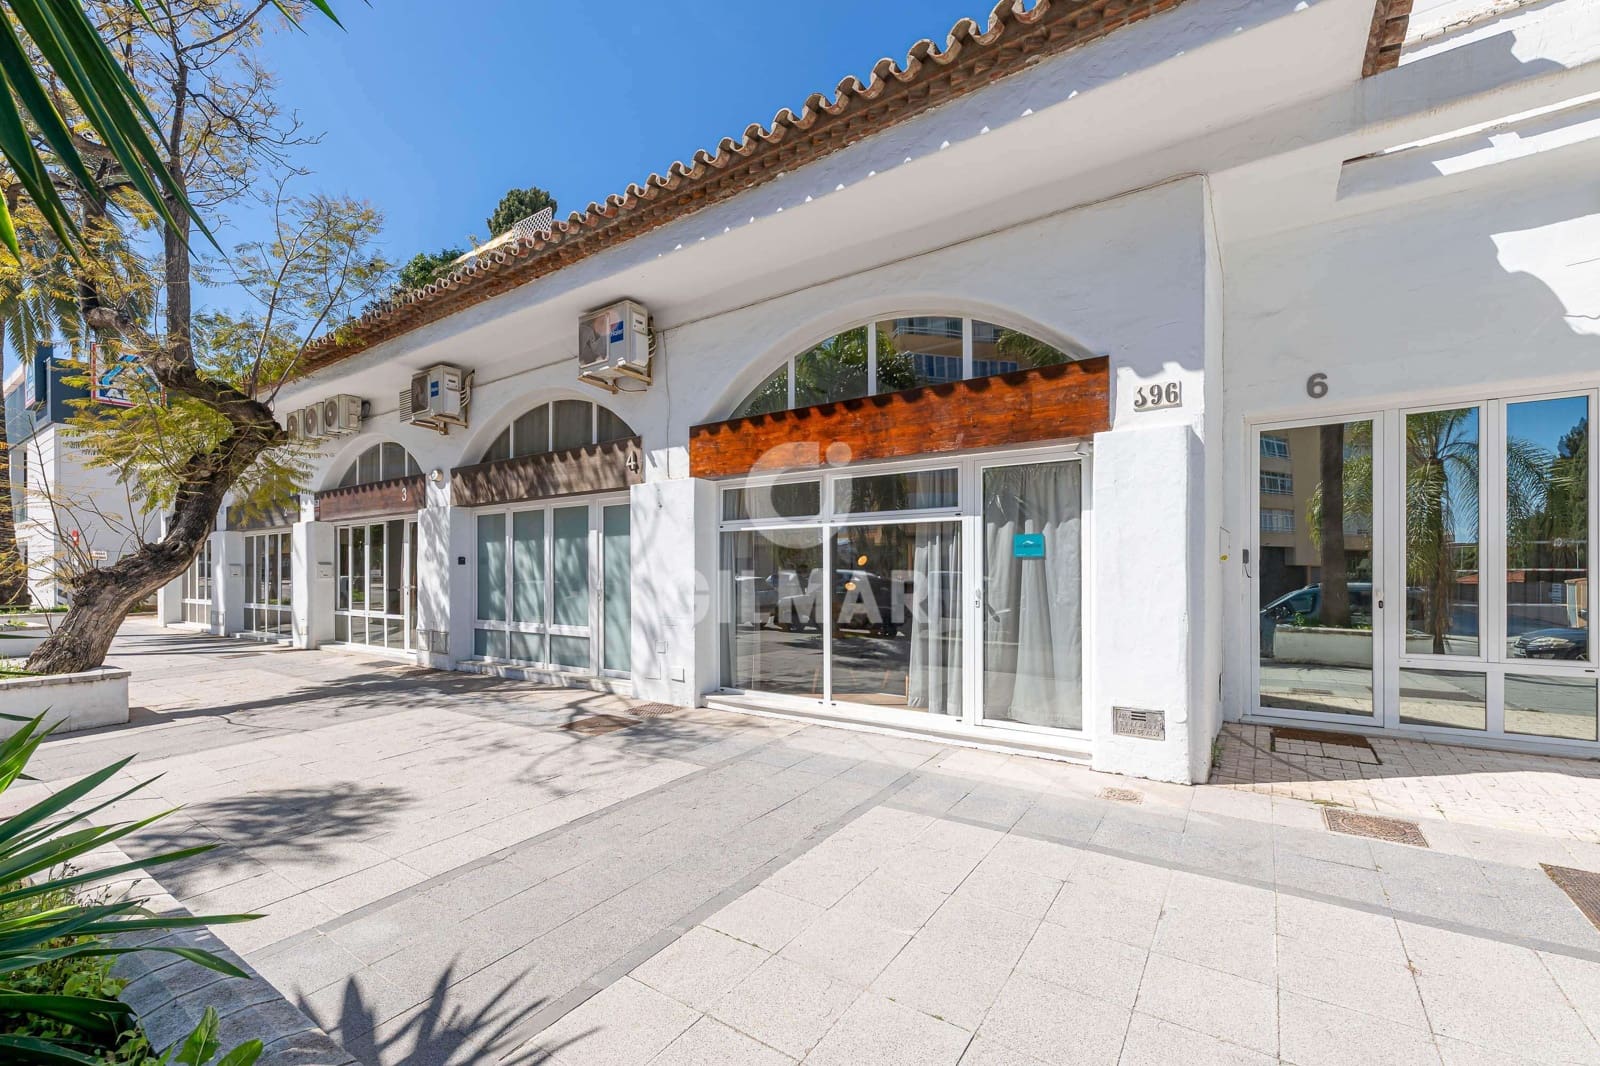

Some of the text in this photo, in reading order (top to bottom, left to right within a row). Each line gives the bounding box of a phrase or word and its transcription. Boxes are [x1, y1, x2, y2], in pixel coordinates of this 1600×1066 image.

[1306, 372, 1329, 399] 6
[626, 450, 638, 471] 4
[401, 487, 407, 501] 3
